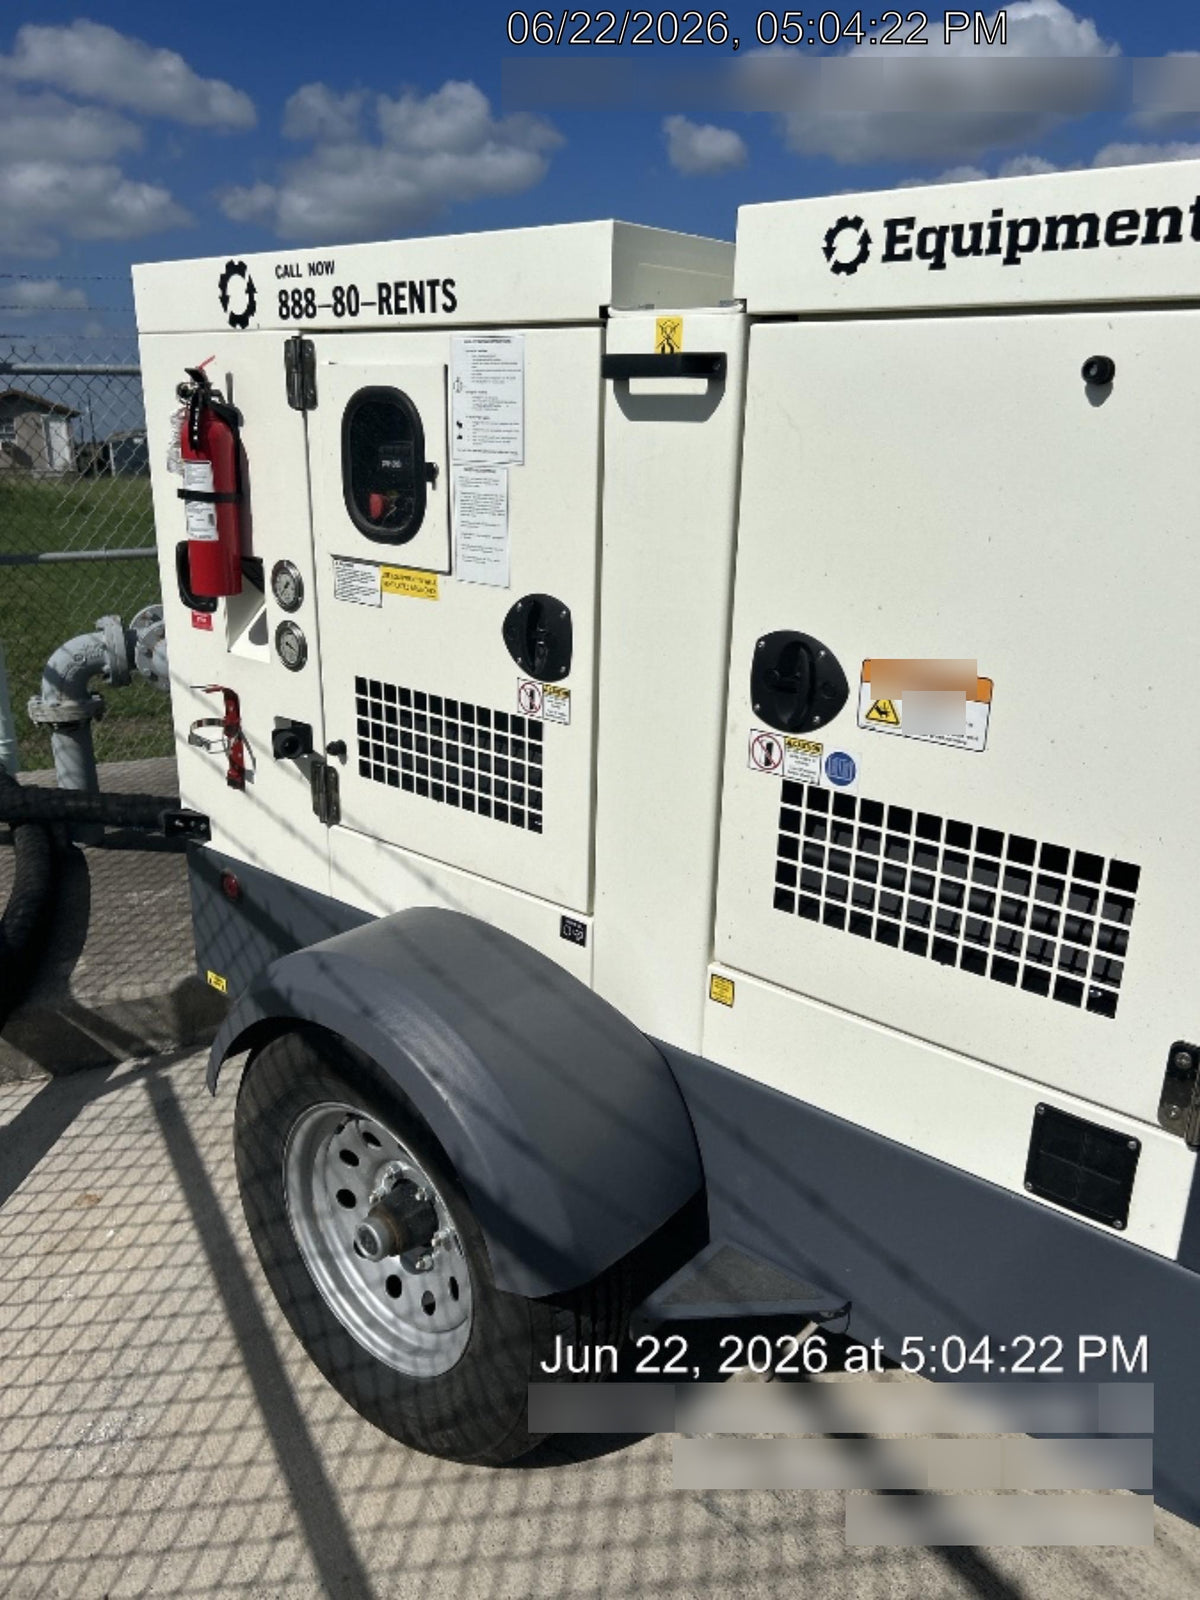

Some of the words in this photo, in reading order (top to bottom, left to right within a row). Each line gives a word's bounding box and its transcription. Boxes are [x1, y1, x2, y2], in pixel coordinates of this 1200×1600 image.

[275, 263, 303, 280] CALL
[308, 260, 336, 277] NOW
[277, 278, 458, 321] 888-80-RENTS
